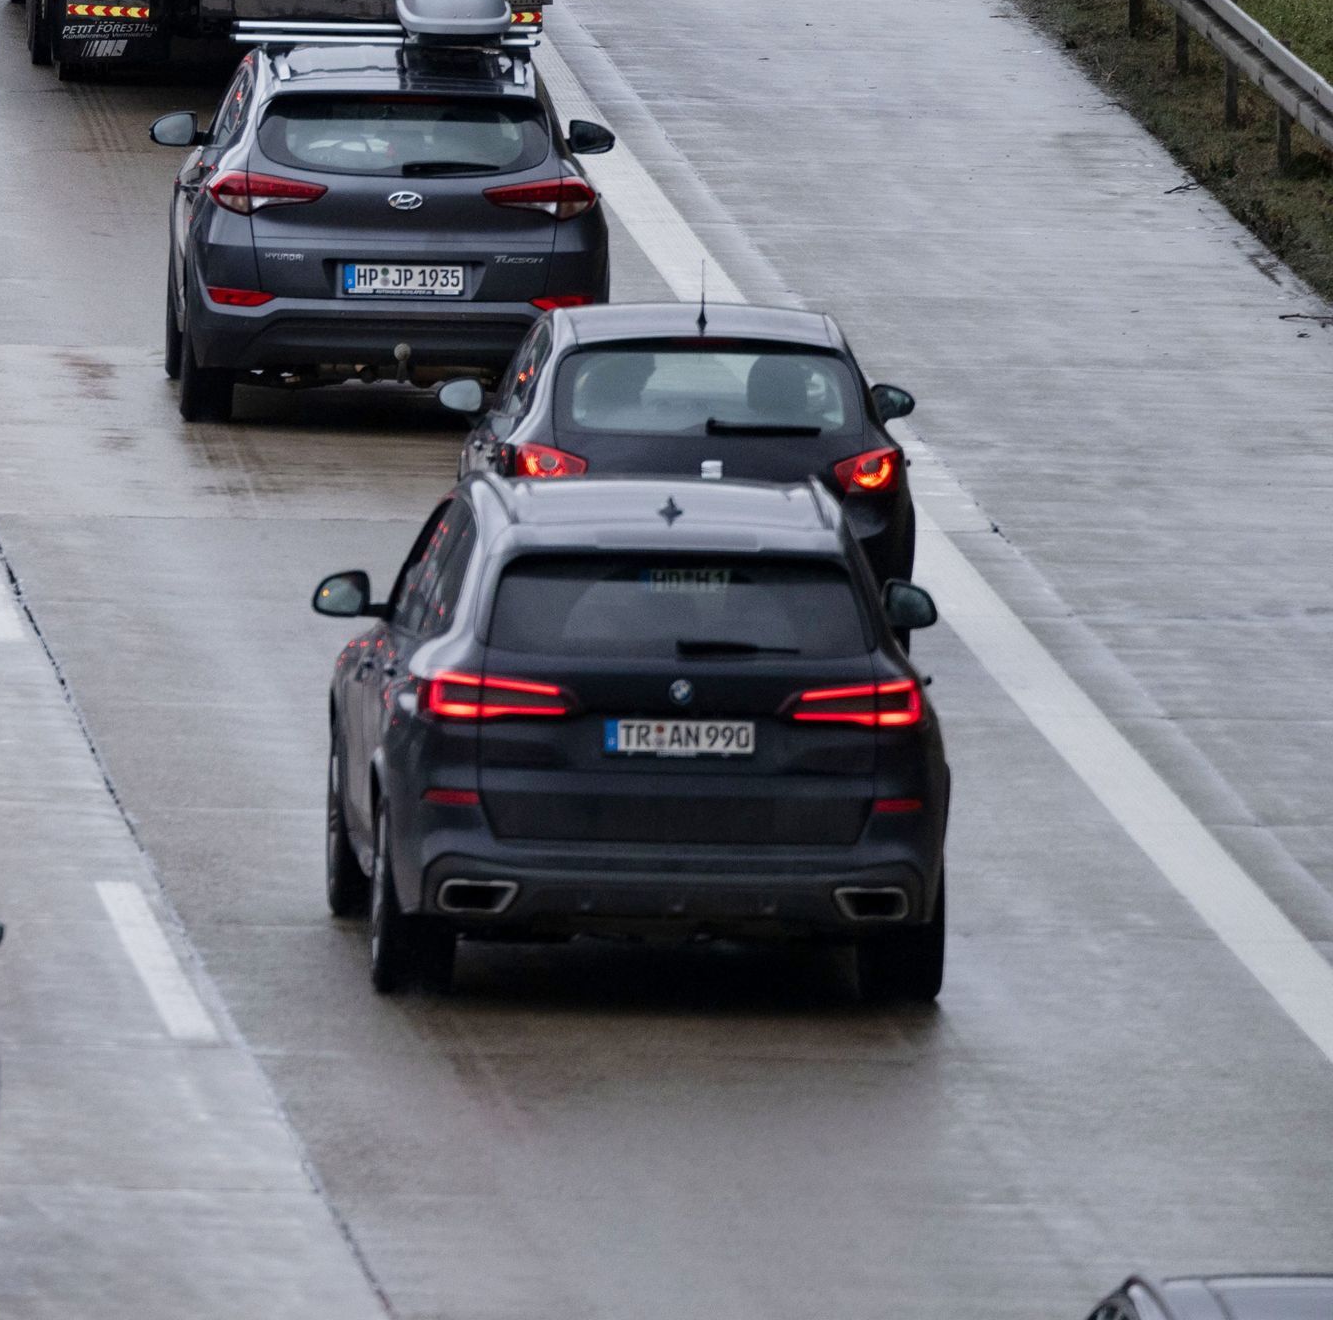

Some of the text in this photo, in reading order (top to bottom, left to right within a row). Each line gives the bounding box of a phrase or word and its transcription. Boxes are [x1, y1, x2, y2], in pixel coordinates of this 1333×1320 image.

[62, 24, 95, 34] PETIT
[264, 251, 304, 262] HYUNDAI
[356, 267, 460, 288] HP JP 1935
[620, 724, 750, 749] TR AN 990
